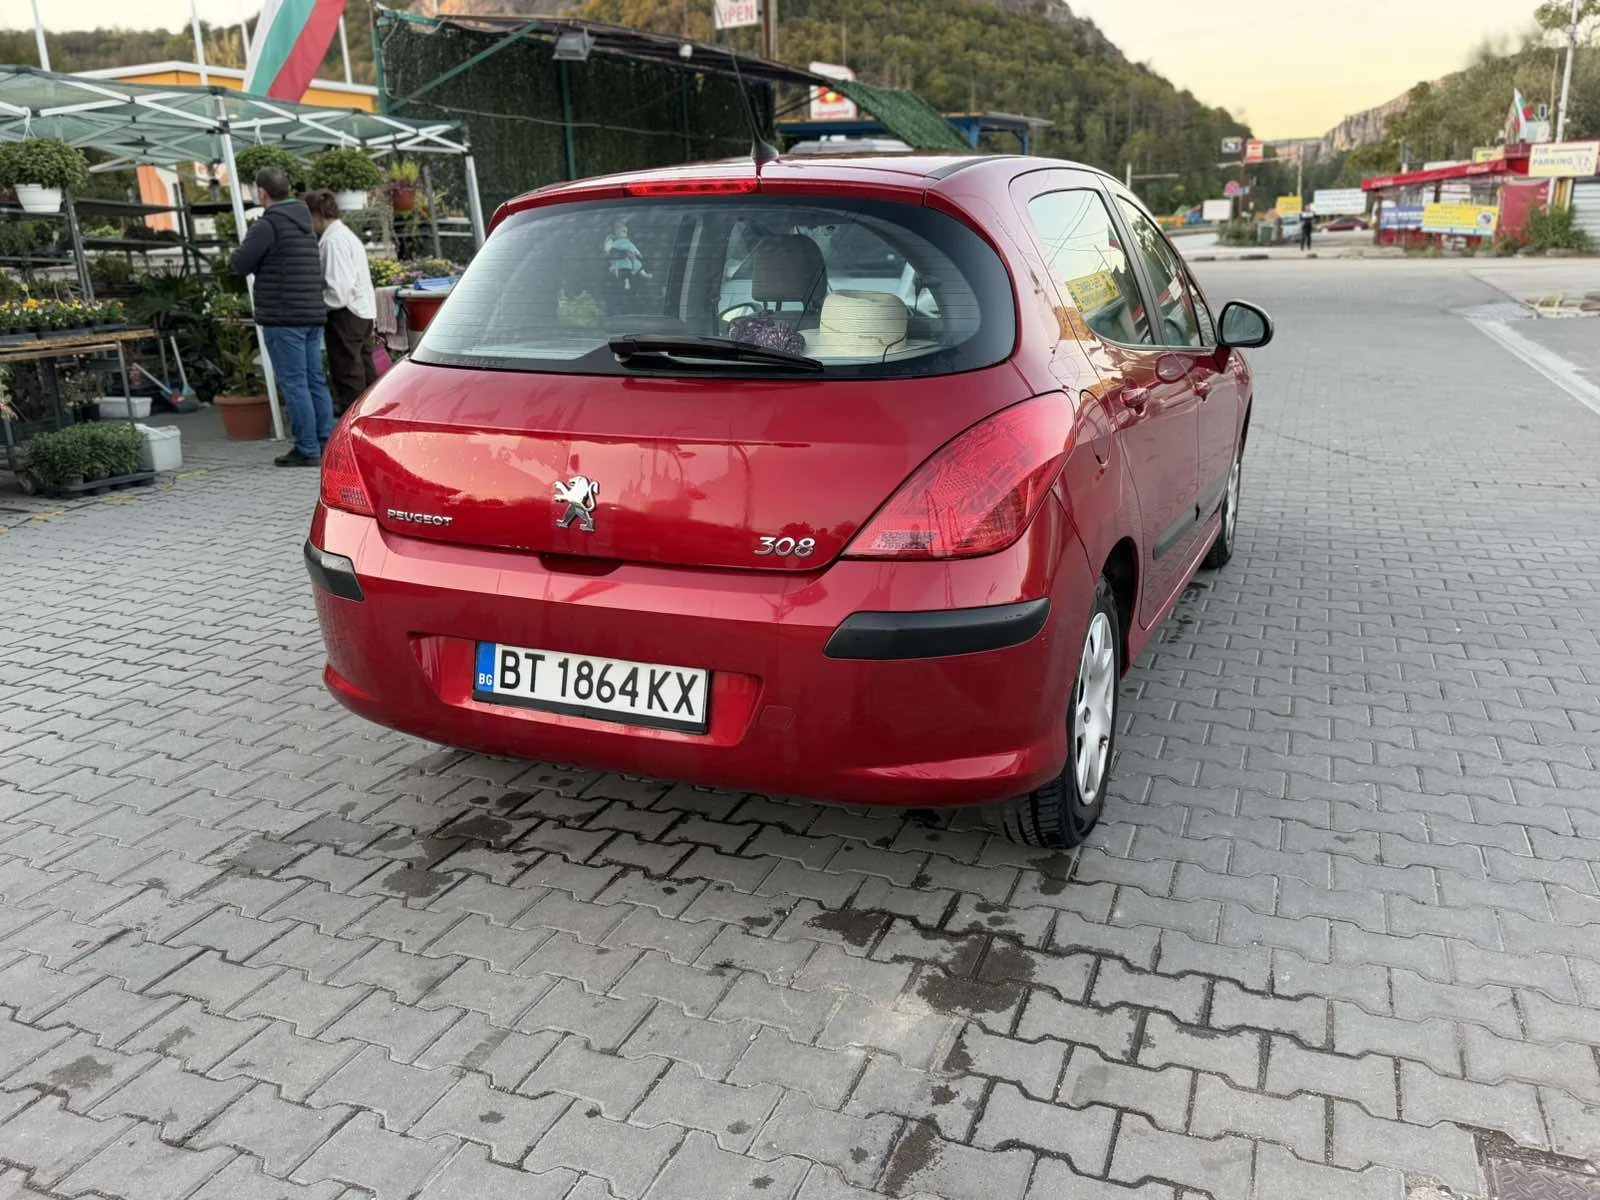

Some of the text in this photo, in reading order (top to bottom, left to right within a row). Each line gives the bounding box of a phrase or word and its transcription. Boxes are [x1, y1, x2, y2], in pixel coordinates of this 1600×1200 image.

[387, 508, 453, 526] PEUGEOT
[754, 536, 816, 557] 308
[478, 673, 493, 686] BG
[500, 649, 546, 692] BT
